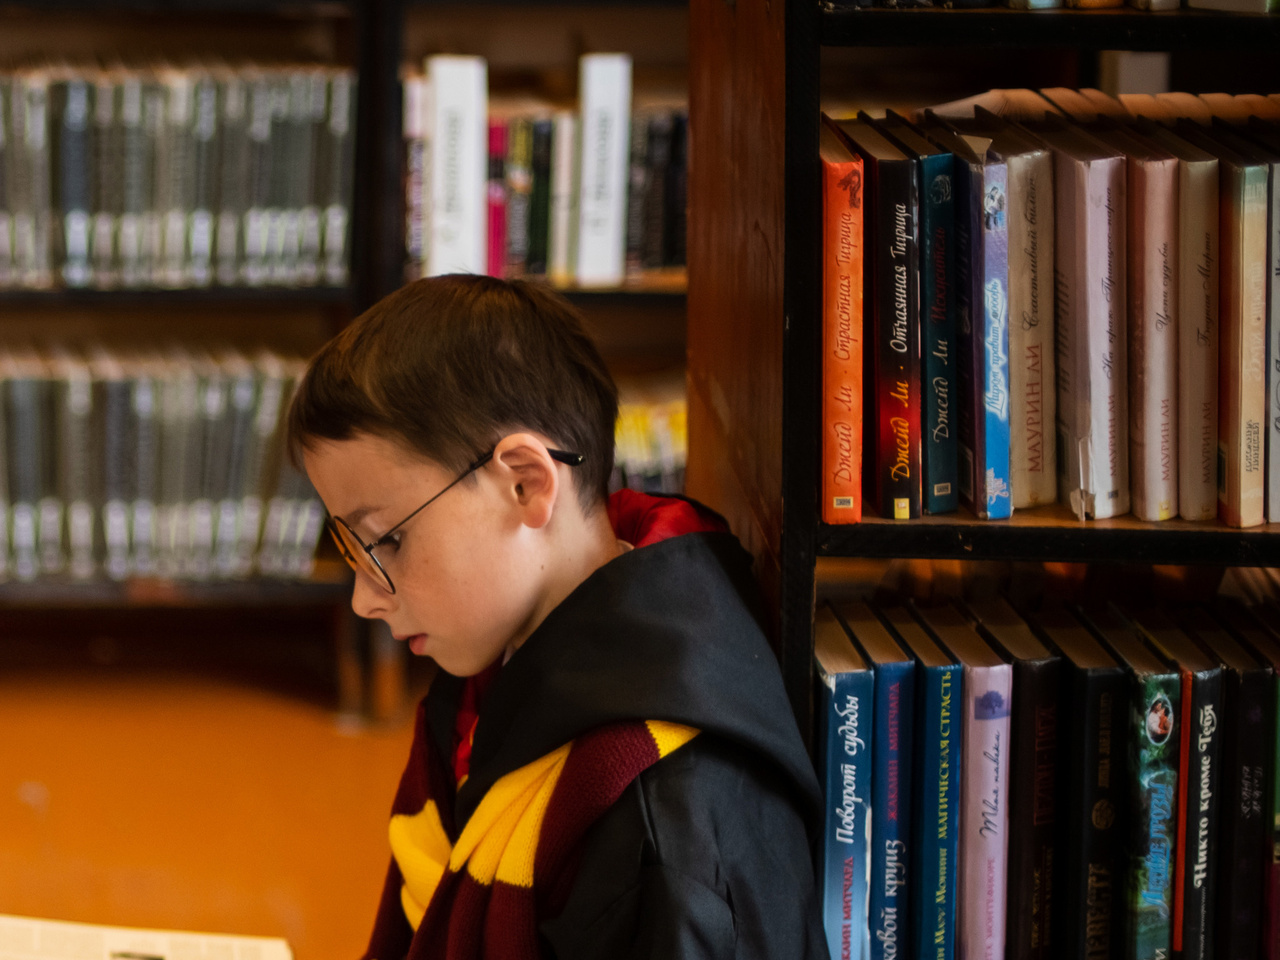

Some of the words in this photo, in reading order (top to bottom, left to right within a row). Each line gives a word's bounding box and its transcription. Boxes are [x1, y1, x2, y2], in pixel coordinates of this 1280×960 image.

[890, 202, 913, 259] Тигрица
[1023, 176, 1038, 226] билет
[834, 211, 858, 266] Тигрица
[1159, 241, 1170, 287] судьбы
[1196, 231, 1213, 291] Марта
[931, 227, 950, 324] Искуситель
[1022, 230, 1039, 332] Счастливый
[833, 275, 858, 361] Страстная
[890, 264, 908, 353] Отчаянная
[1106, 309, 1116, 344] краю
[932, 339, 949, 366] Ли
[1026, 344, 1040, 373] ЛИ
[1102, 351, 1115, 381] На
[834, 386, 852, 411] Ли
[891, 380, 910, 407] Ли
[932, 377, 950, 443] Джейд
[1108, 394, 1116, 409] ЛИ
[1161, 399, 1170, 419] ЛИ
[1201, 401, 1211, 421] ЛИ
[833, 422, 852, 486] Джейд
[889, 417, 910, 482] Джейд
[1027, 382, 1042, 474] МАУРИН
[1108, 411, 1118, 476] МАУРИН
[1161, 421, 1171, 481] МАУРИН
[1201, 424, 1212, 484] МАУРИН
[834, 695, 865, 757] судьбы
[888, 681, 900, 752] МИТЧАРД
[939, 671, 953, 738] СТРАСТЬ
[1197, 703, 1218, 754] Тебя
[835, 763, 862, 845] Поворот
[887, 760, 900, 822] ЖАКЛИН
[937, 740, 951, 840] МАГИЧЕСКАЯ
[1198, 755, 1213, 813] кроме
[883, 839, 906, 897] круиз
[1192, 818, 1210, 889] Никто
[841, 856, 854, 920] МИТЧАРД
